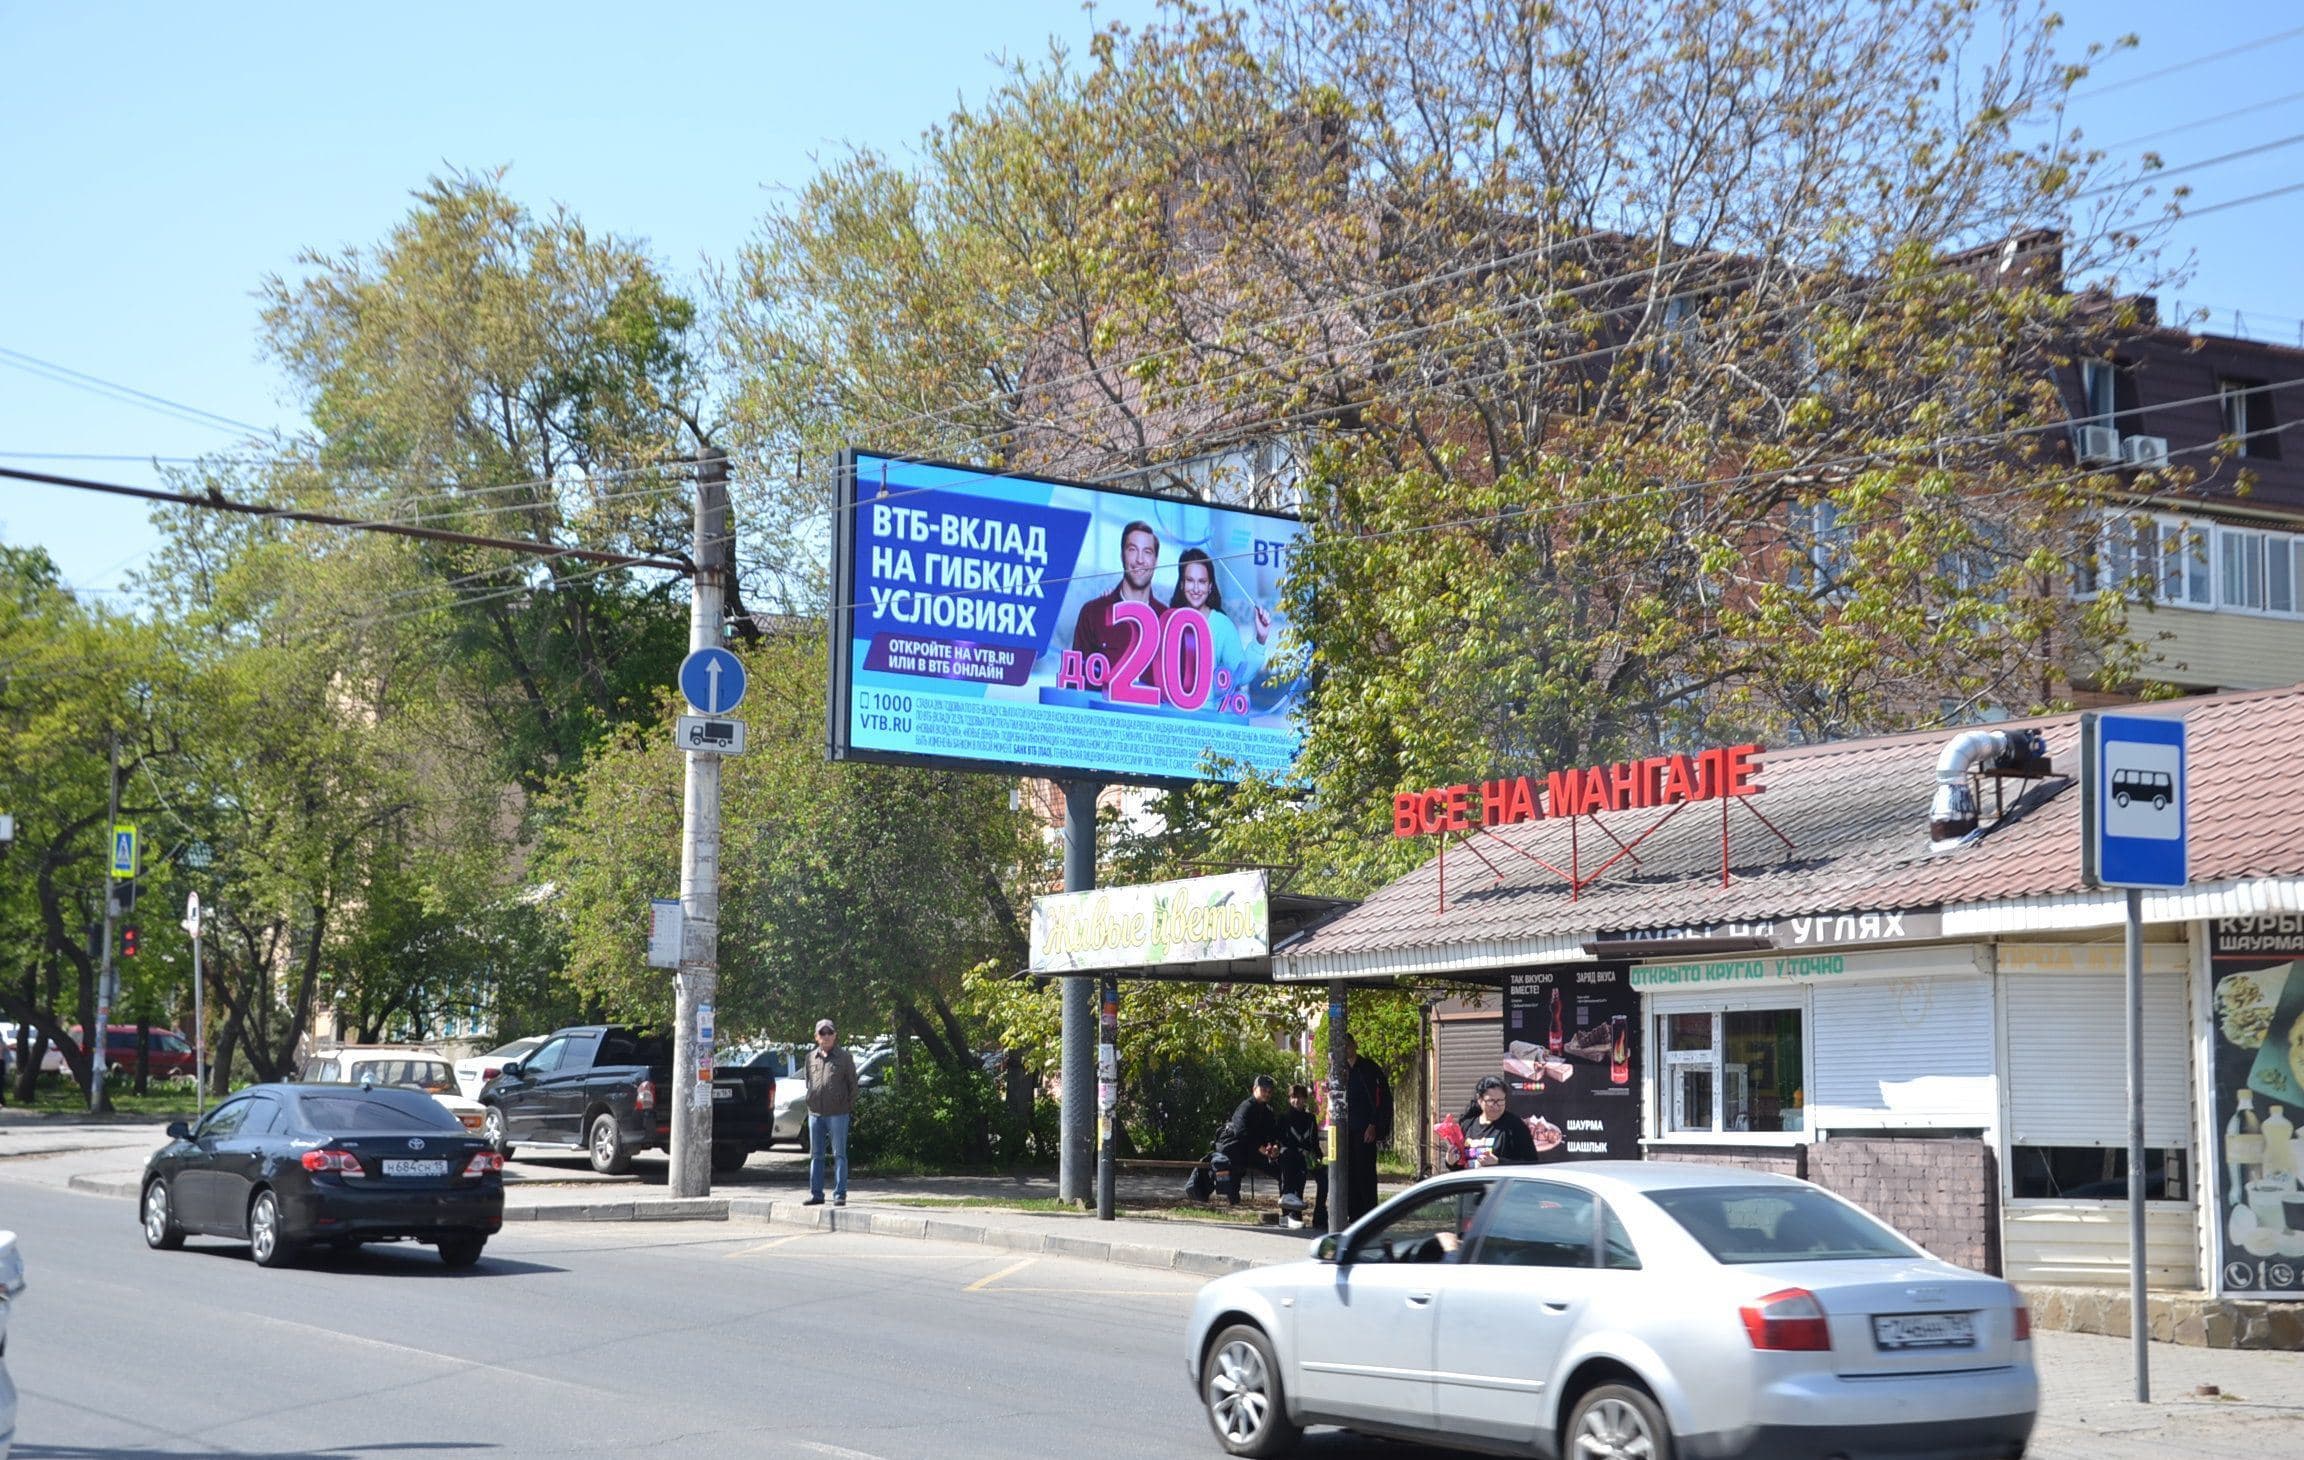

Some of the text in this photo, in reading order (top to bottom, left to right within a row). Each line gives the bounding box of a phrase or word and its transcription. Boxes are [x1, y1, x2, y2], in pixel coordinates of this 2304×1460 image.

[872, 504, 1048, 565] ВТБ-ВКЛАД
[1254, 538, 1291, 569] ВТ
[871, 546, 1045, 599] НА ГИБКИХ
[870, 586, 1037, 638] УСЛОВИЯХ
[889, 638, 1015, 665] ОТКРОЙТЕ НА VTB.RU
[888, 655, 1004, 680] ИЛИ В ВТБ ОНЛАЙН
[873, 692, 912, 713] 1000
[860, 714, 912, 733] VTB.RU
[1394, 744, 1764, 838] ВСЕ НА МАНГАЛЕ
[1790, 910, 1906, 944] УГЛЯХ
[2218, 913, 2304, 934] КУРЫ
[2219, 935, 2304, 950] ШАУРМА
[1510, 973, 1553, 984] ТАК ВКУСНО
[1576, 971, 1616, 984] ЗАРЯД ВКУСА
[1630, 963, 1700, 986] ОТКРЫТО
[1567, 1120, 1604, 1131] ШАУРМА
[1567, 1141, 1608, 1153] ШАШЛЫК
